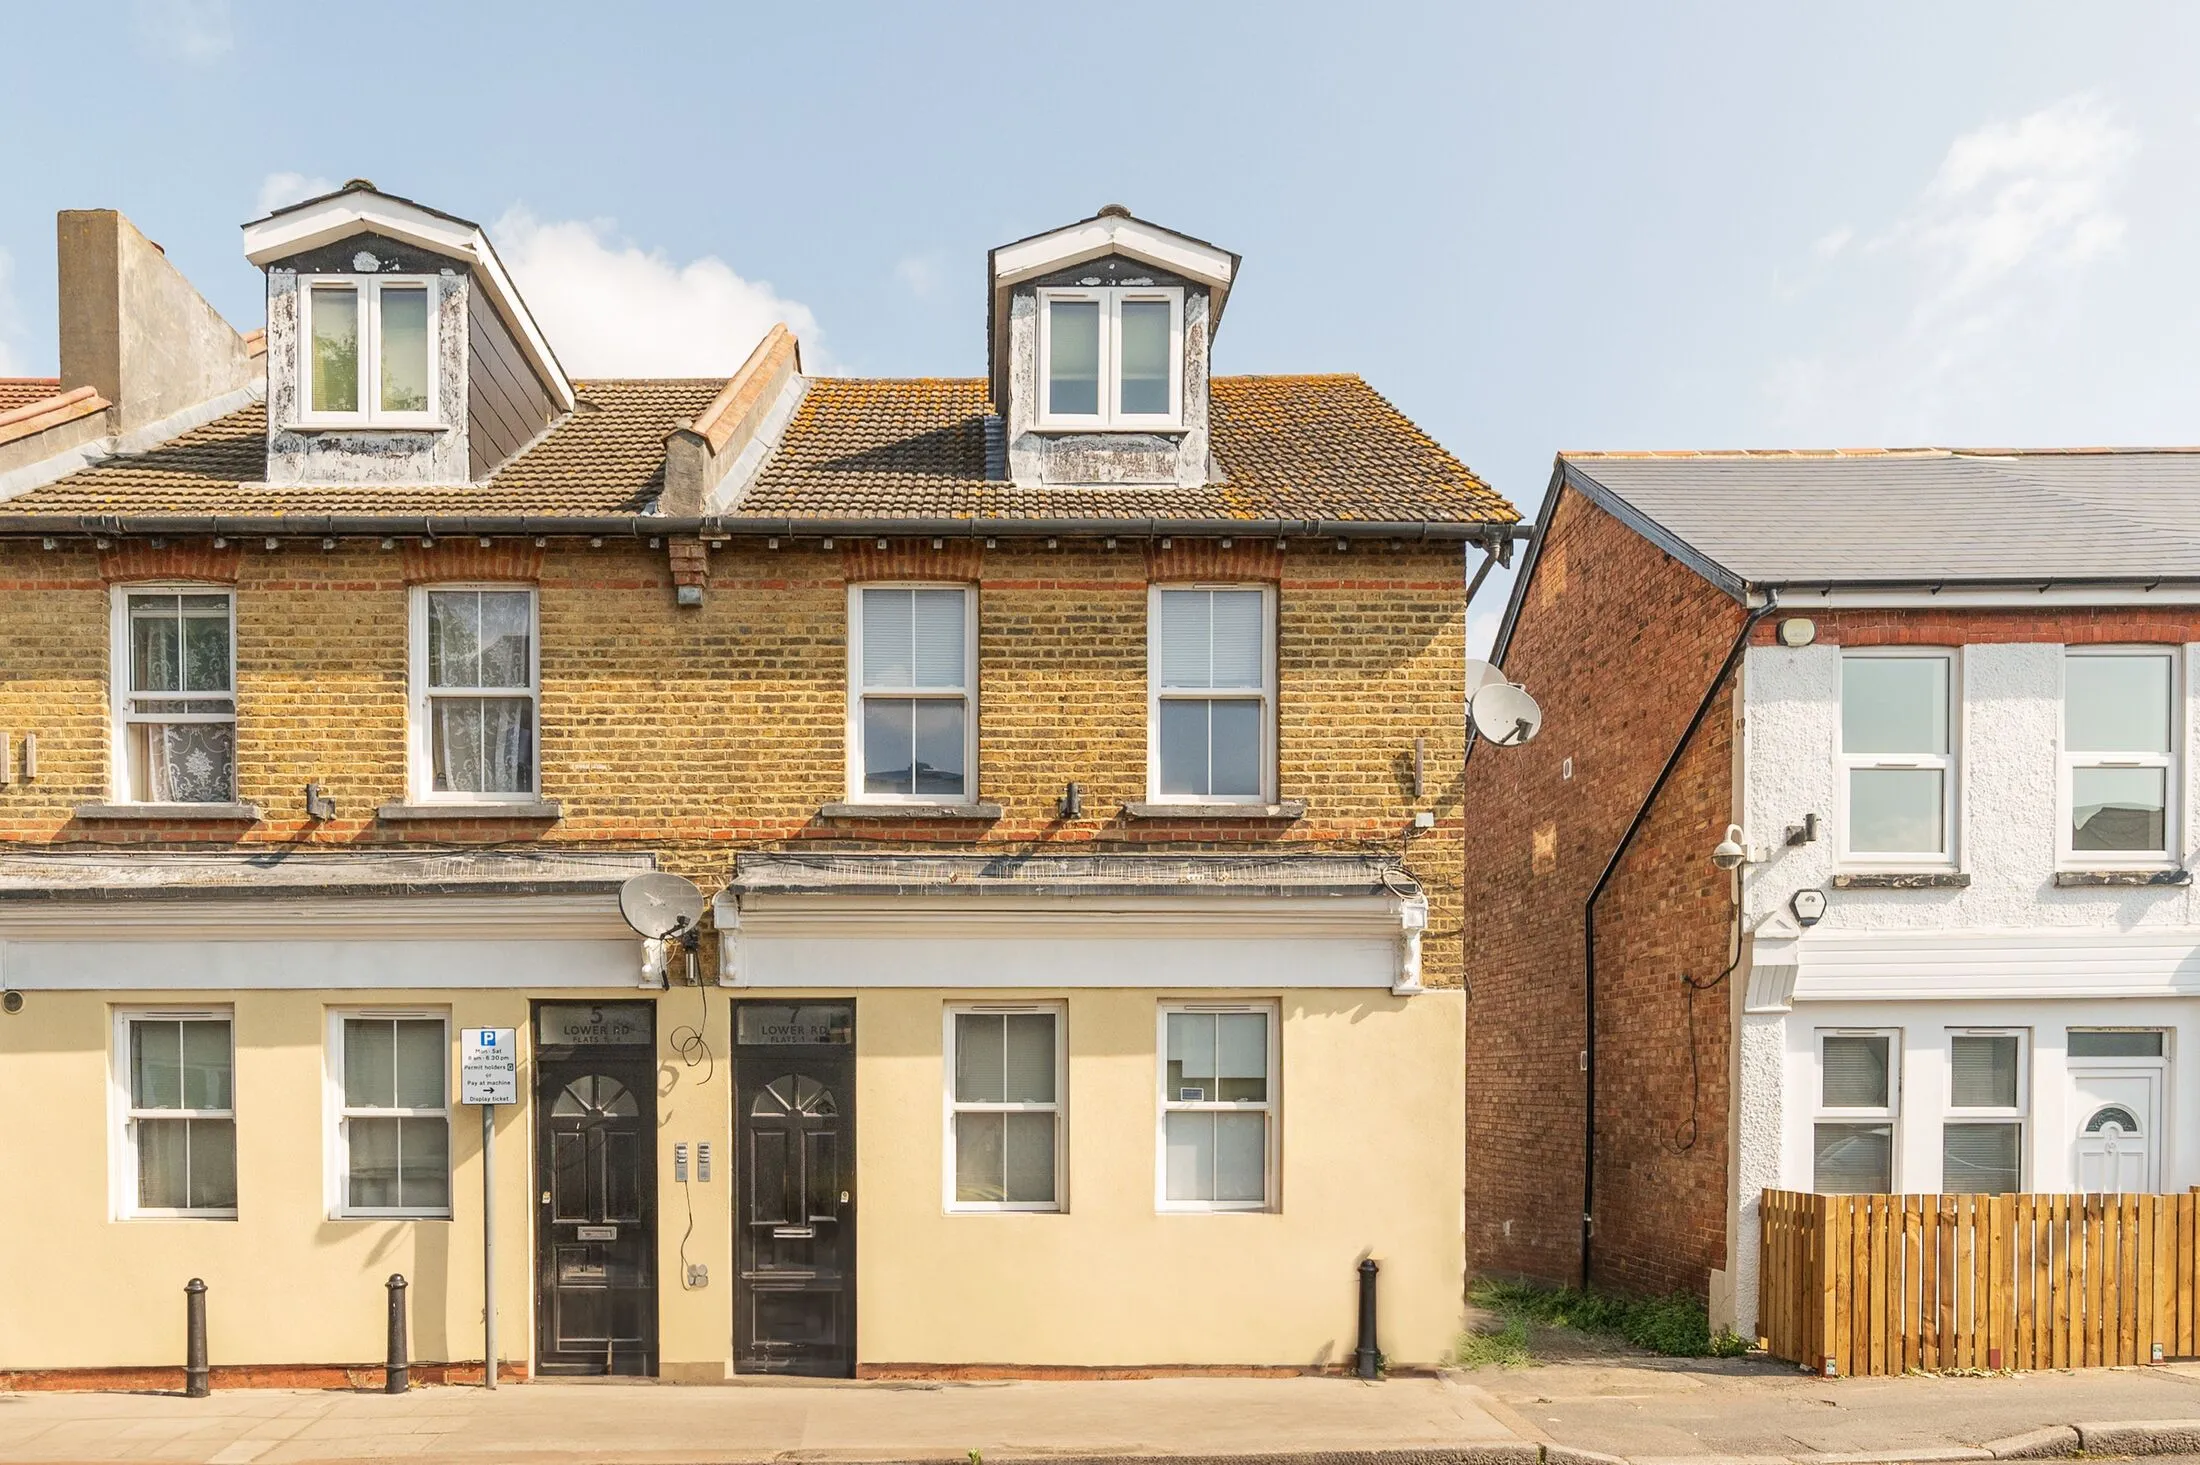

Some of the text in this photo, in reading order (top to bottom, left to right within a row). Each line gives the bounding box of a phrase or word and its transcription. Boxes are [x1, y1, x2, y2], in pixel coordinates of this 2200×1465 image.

[590, 1006, 603, 1024] 5
[789, 1006, 801, 1024] 7
[564, 1025, 629, 1035] LOWER RD
[762, 1025, 827, 1035] LOWER RD
[484, 1033, 494, 1045] P
